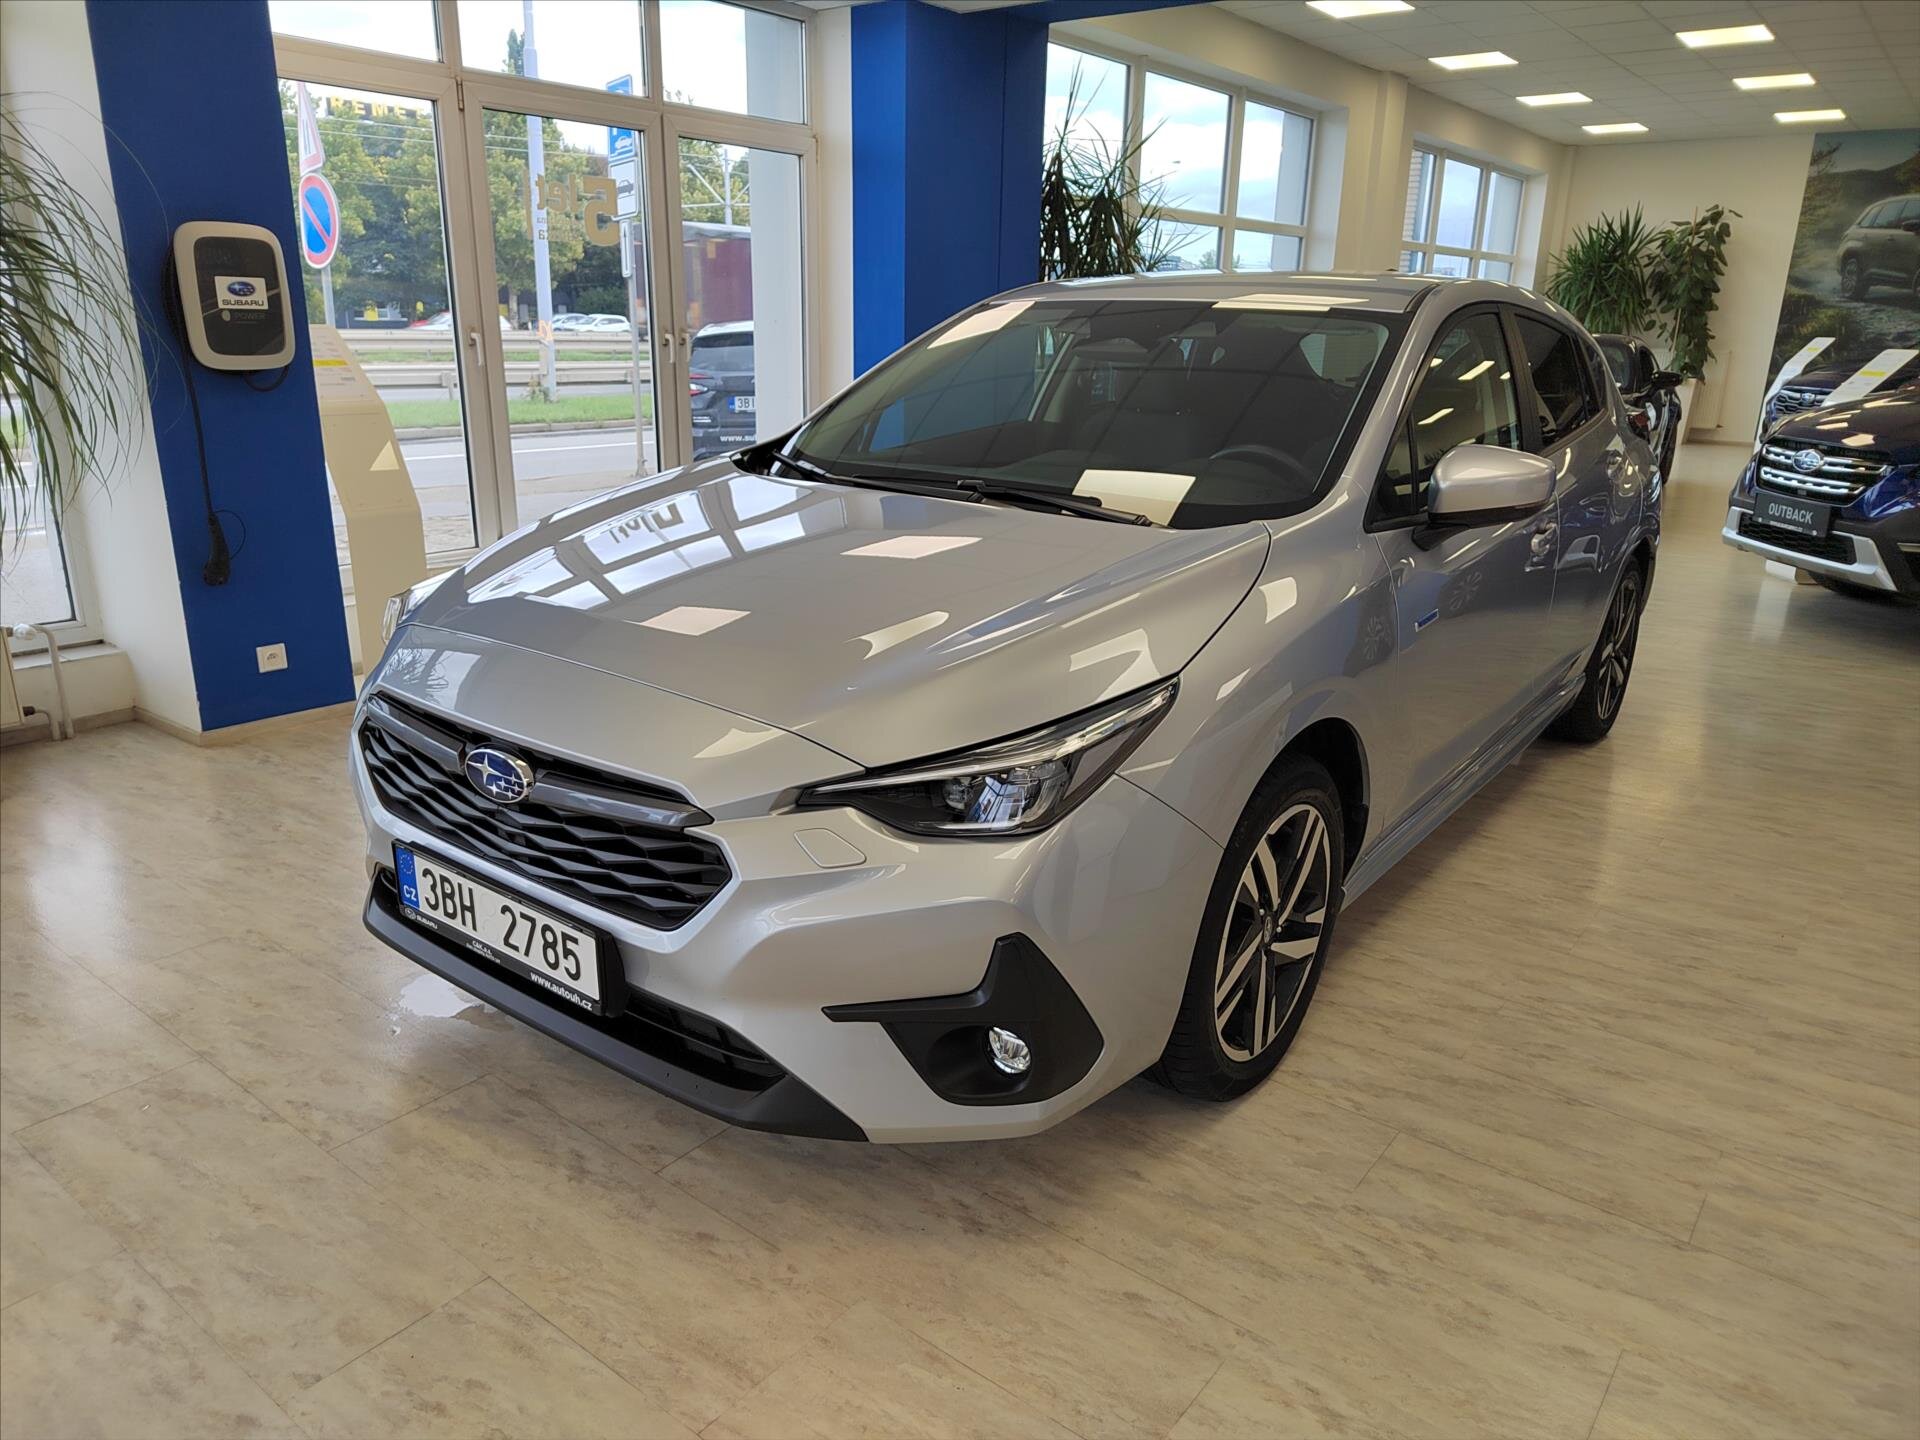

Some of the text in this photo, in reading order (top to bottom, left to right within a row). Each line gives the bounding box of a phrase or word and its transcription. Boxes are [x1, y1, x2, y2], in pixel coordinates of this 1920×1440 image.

[222, 299, 264, 307] SUBARU
[1768, 503, 1814, 525] OUTBACK
[403, 885, 417, 902] CZ
[416, 914, 438, 930] SUBARU
[421, 867, 581, 982] 3BH 2785
[530, 972, 593, 1011] www.autouh.cz
